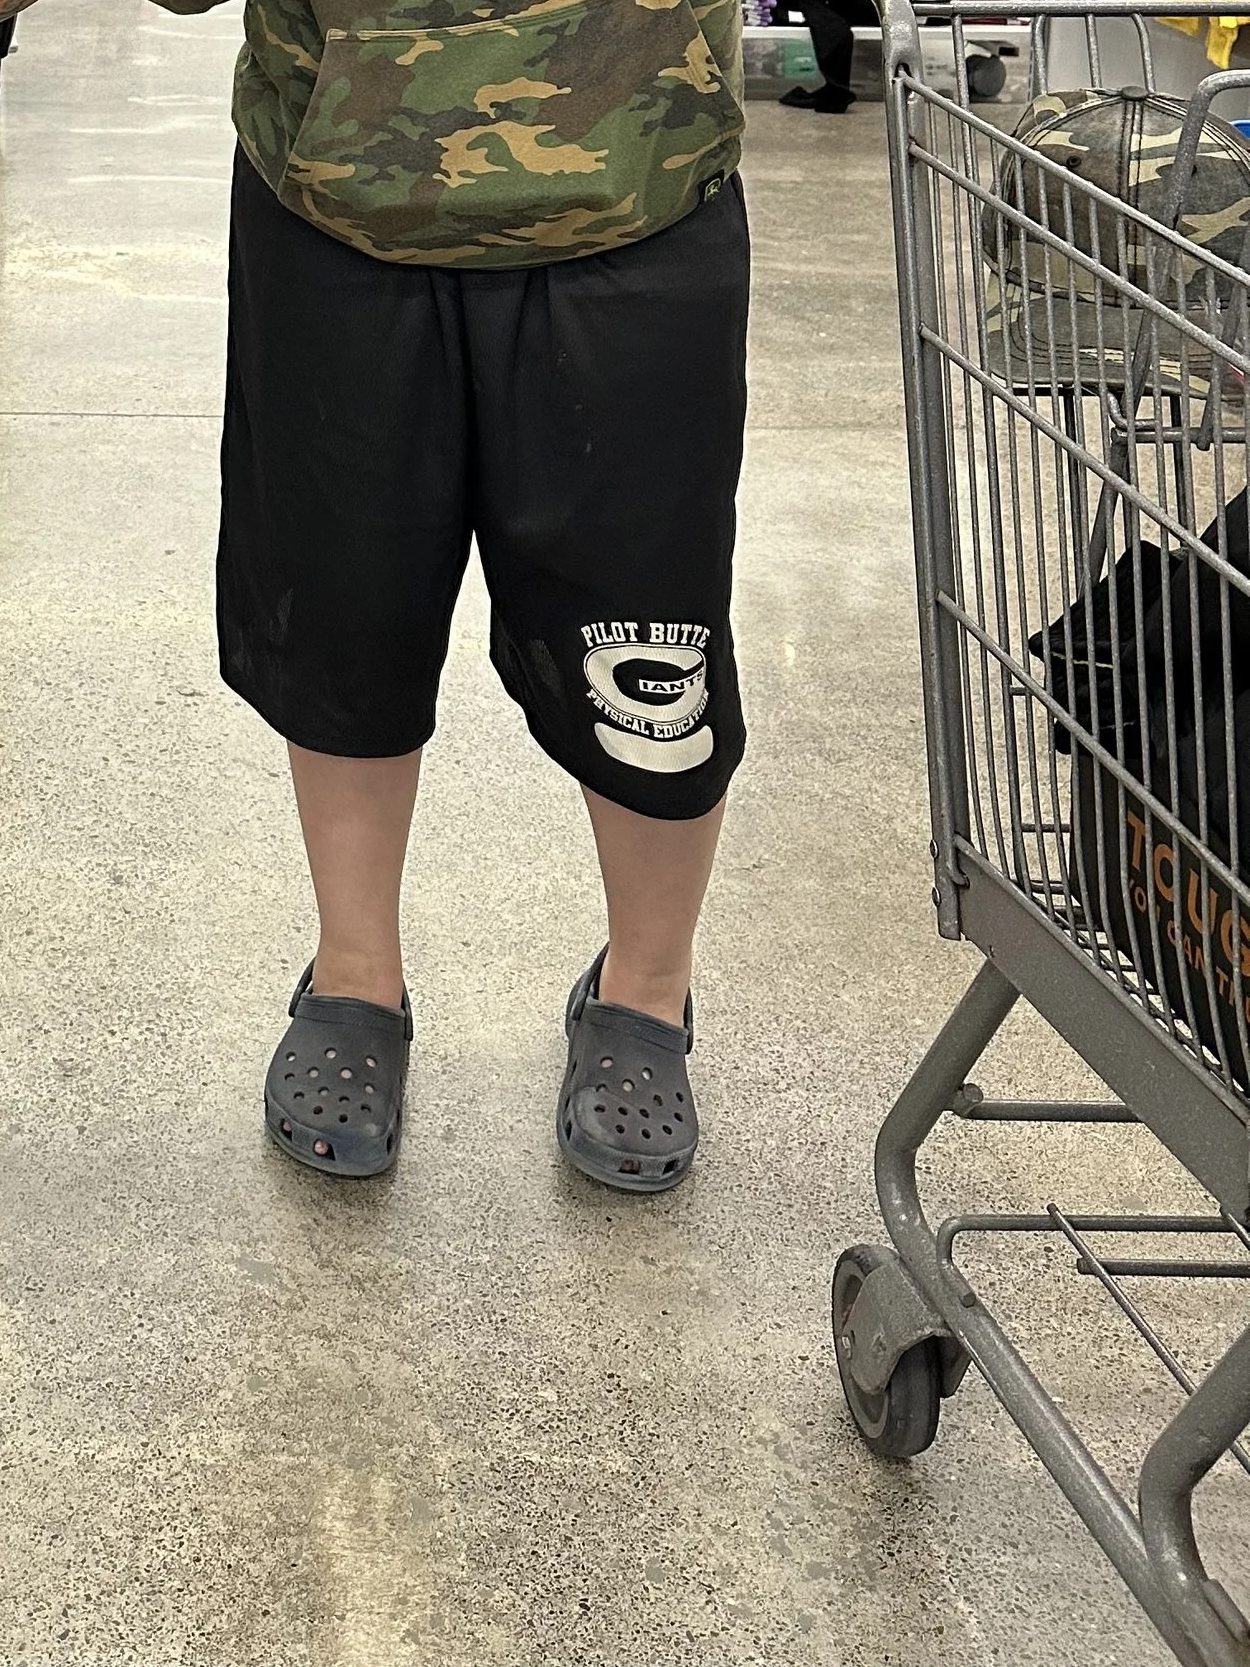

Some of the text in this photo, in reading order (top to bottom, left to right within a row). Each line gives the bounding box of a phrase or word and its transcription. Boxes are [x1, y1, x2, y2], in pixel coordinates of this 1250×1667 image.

[580, 621, 711, 650] PILOT BUTTE
[586, 688, 710, 739] PHYSICAL EDUCATION
